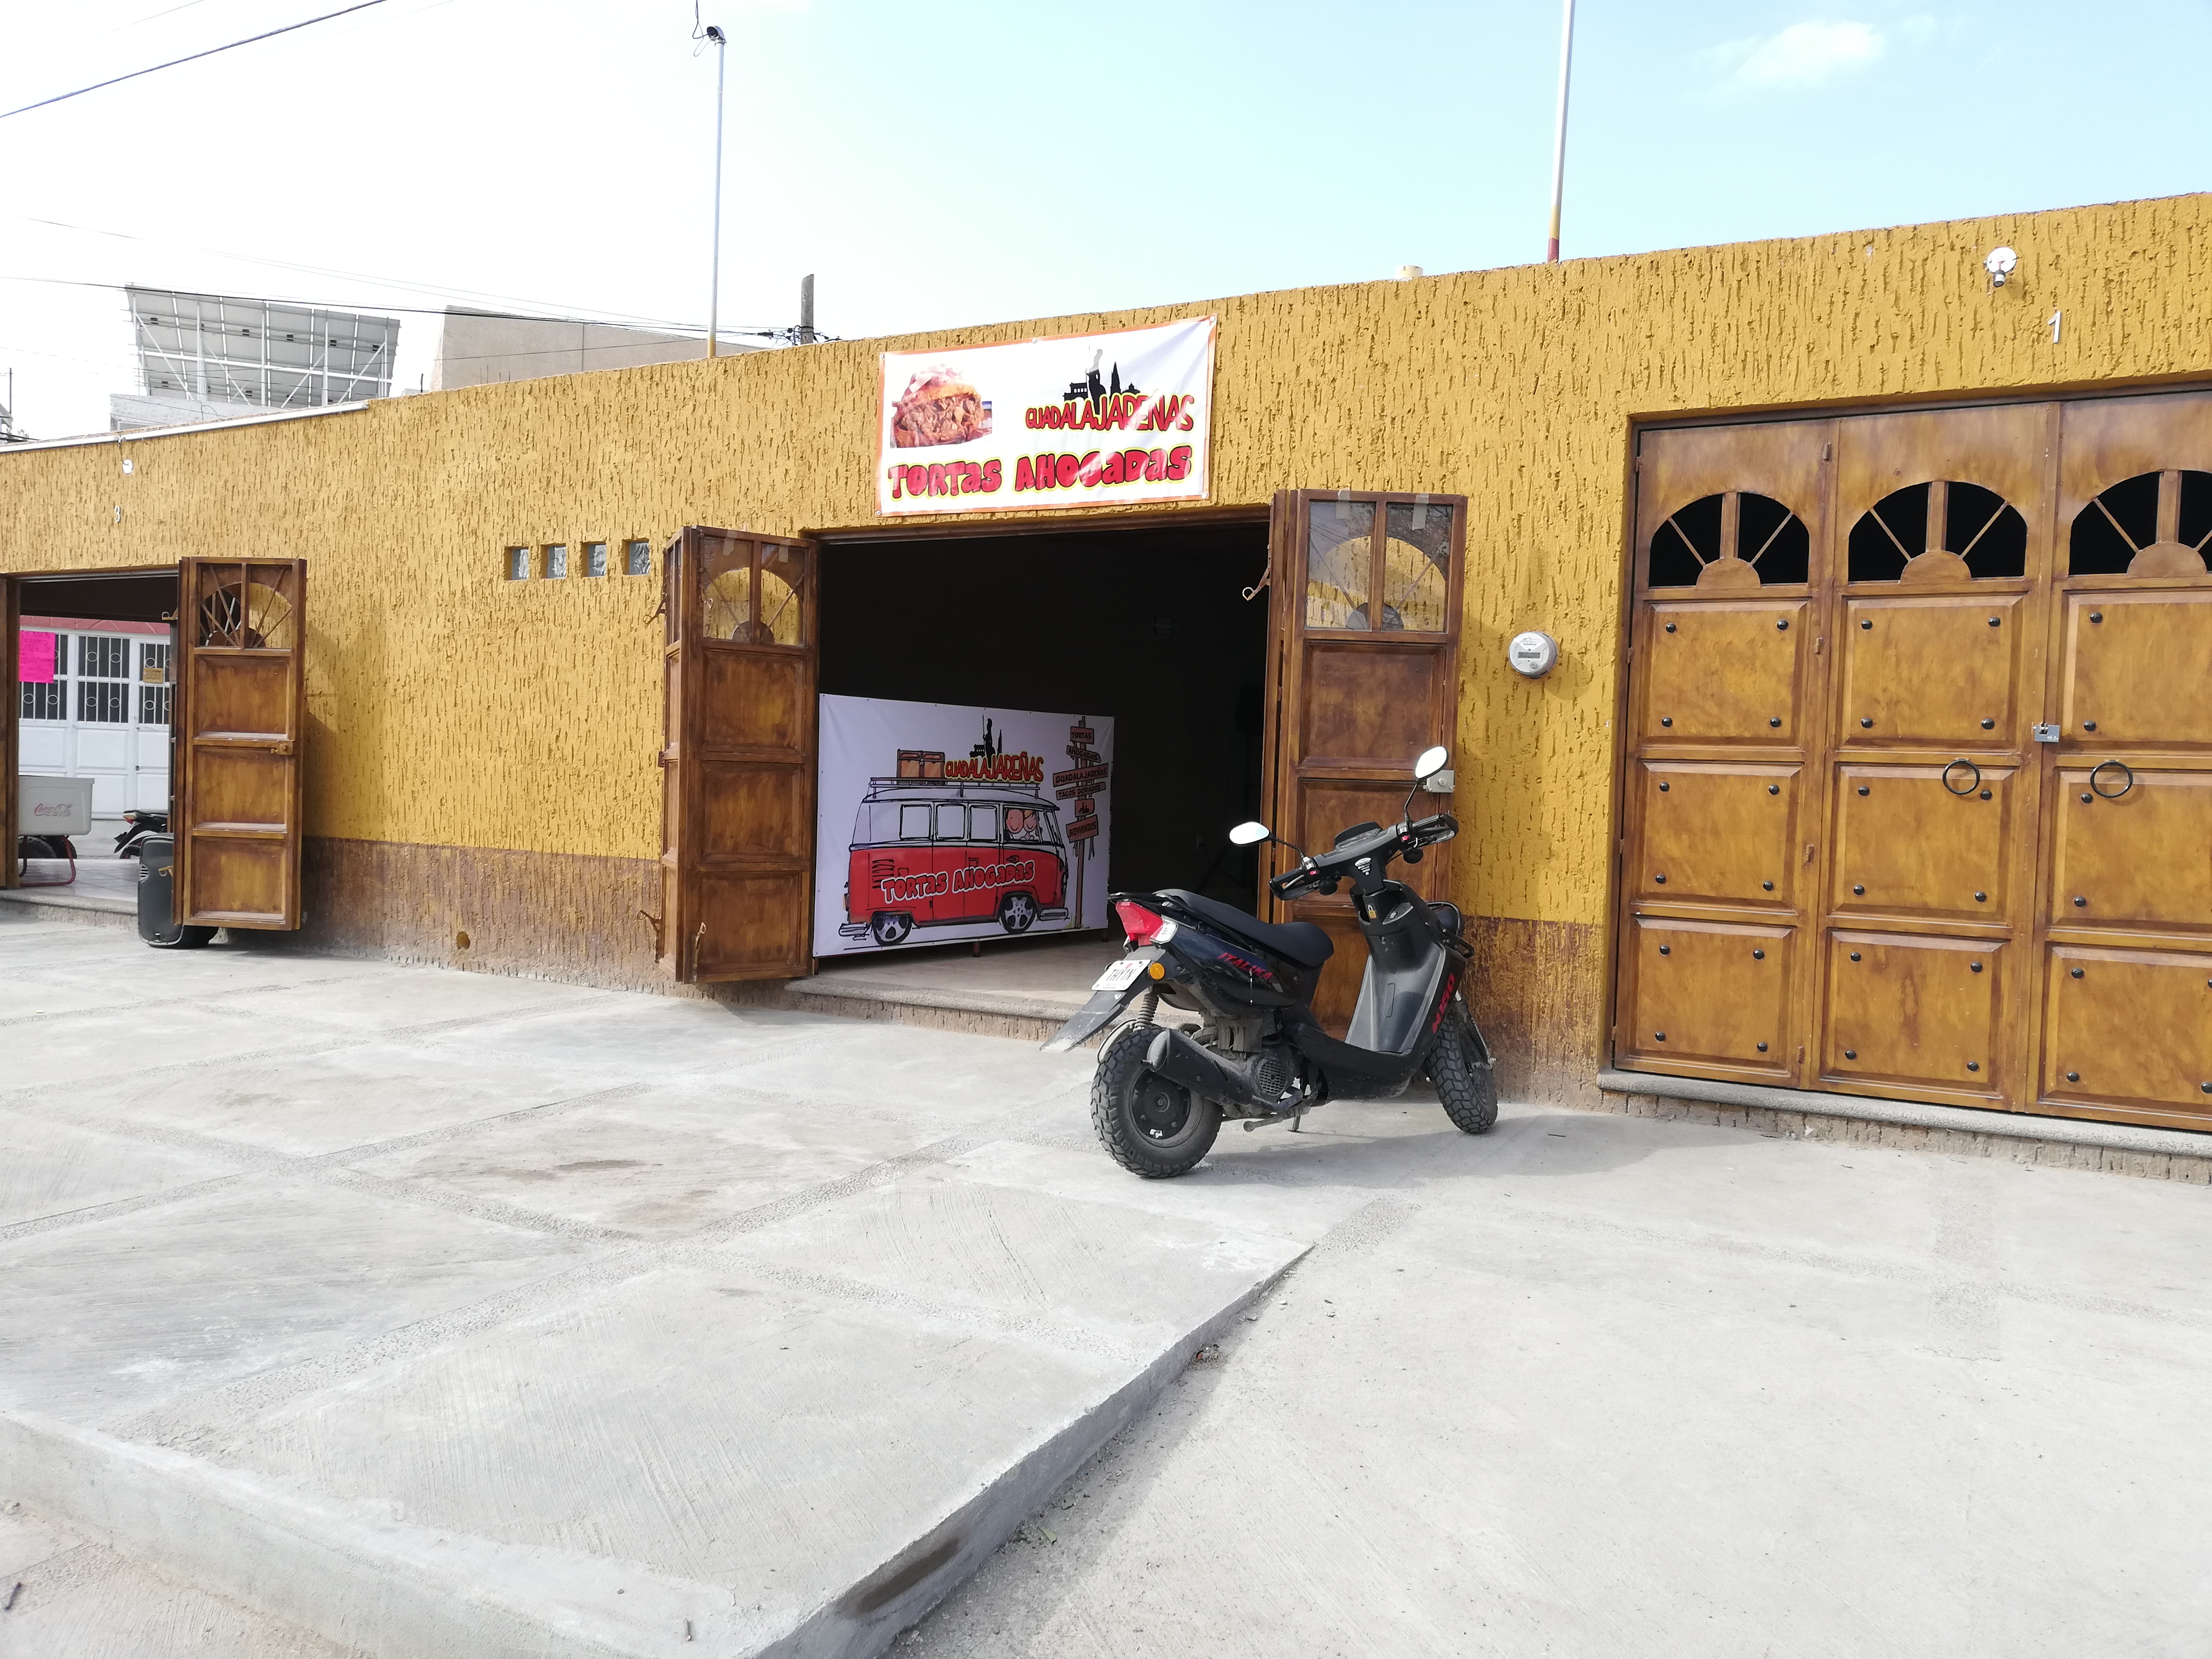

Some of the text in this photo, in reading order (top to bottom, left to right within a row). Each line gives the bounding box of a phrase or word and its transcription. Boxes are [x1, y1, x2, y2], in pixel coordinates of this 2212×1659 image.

[2047, 311, 2061, 344] 1
[114, 505, 121, 523] 3
[1068, 747, 1098, 761] AHOGADAS
[946, 751, 1044, 781] GUADALAJAREÑAS
[1055, 767, 1107, 783] GUADALAJAREÑAS
[1058, 784, 1101, 798] TACOS DORADOS
[1069, 821, 1096, 838] BIENVENIDOS
[1106, 968, 1137, 981] THY1N
[1216, 952, 1273, 980] ITALIKA
